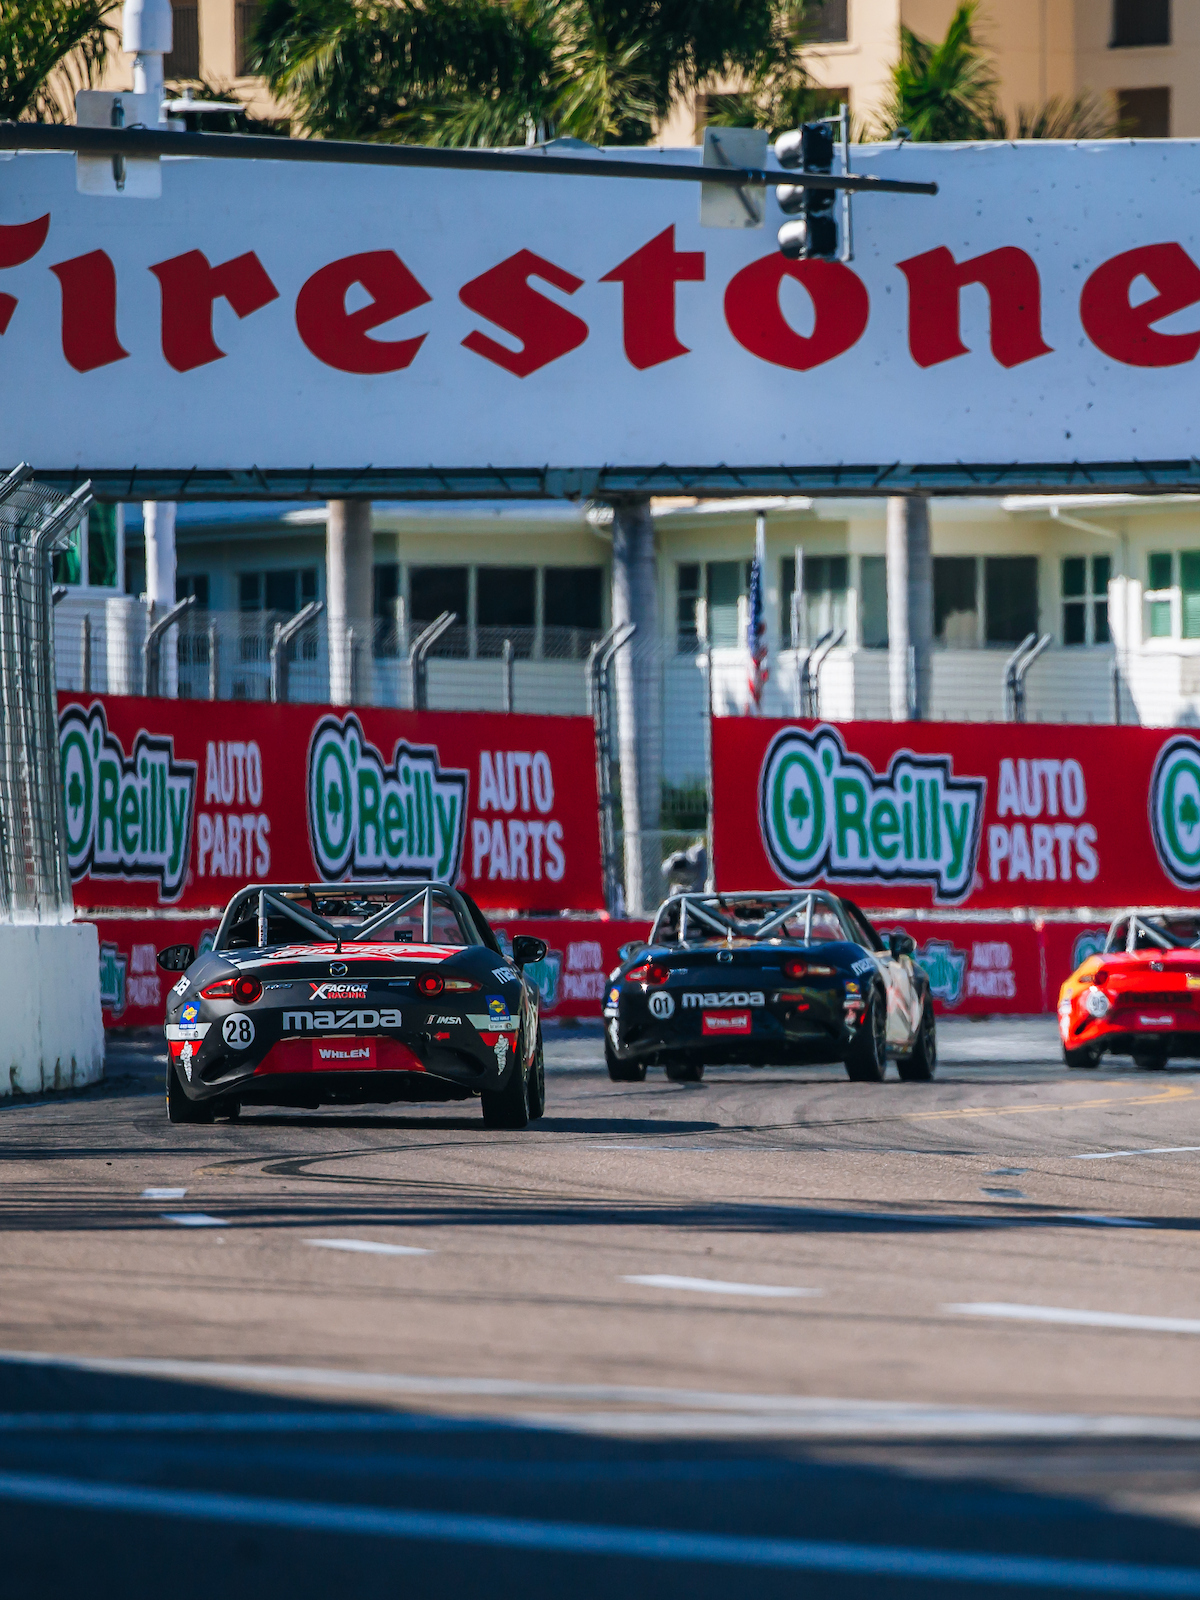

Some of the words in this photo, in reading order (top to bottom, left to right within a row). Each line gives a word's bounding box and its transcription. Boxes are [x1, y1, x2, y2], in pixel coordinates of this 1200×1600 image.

[60, 728, 187, 876] O'Reilly
[204, 740, 263, 806] AUTO
[477, 750, 555, 814] AUTO
[997, 758, 1087, 818] AUTO
[316, 739, 458, 878] O'Reilly
[772, 748, 970, 880] O'Reilly
[197, 812, 271, 878] PARTS
[471, 818, 566, 882] PARTS
[988, 823, 1099, 882] PARTS
[225, 1019, 251, 1043] 28
[437, 1016, 462, 1025] IMSA
[653, 996, 670, 1015] 01
[319, 1047, 370, 1059] WHELEN
